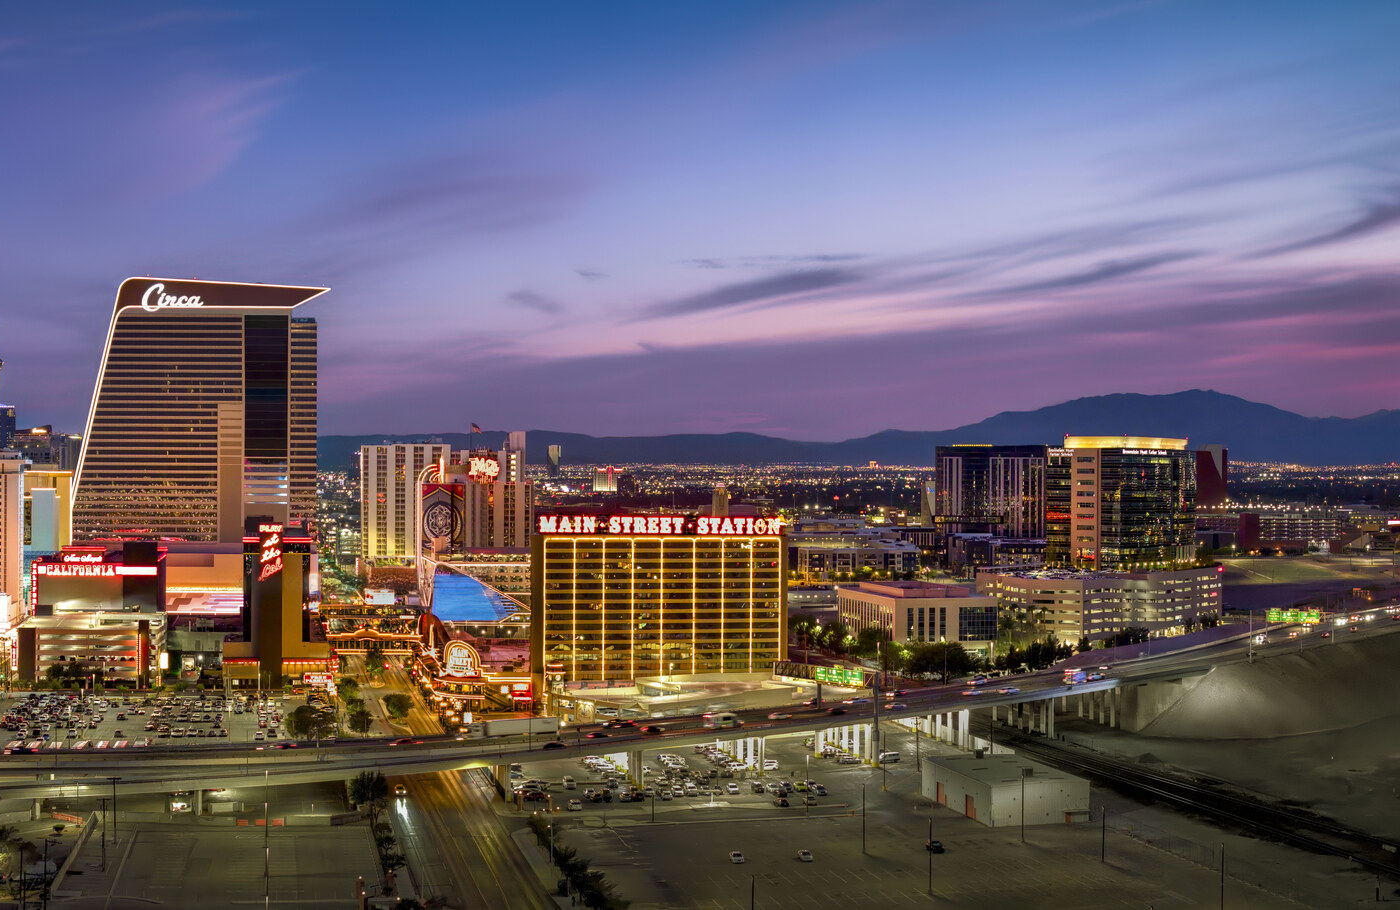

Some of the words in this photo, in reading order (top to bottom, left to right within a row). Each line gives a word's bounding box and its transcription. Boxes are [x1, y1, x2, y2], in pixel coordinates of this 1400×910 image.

[141, 283, 204, 312] Circa
[259, 524, 283, 533] PLAY
[539, 516, 596, 533] MAIN
[608, 516, 685, 534] STREET
[697, 517, 782, 535] STATION
[262, 533, 280, 548] at
[260, 547, 282, 563] the
[46, 564, 115, 576] CALIFORNIA
[257, 557, 283, 581] Cal
